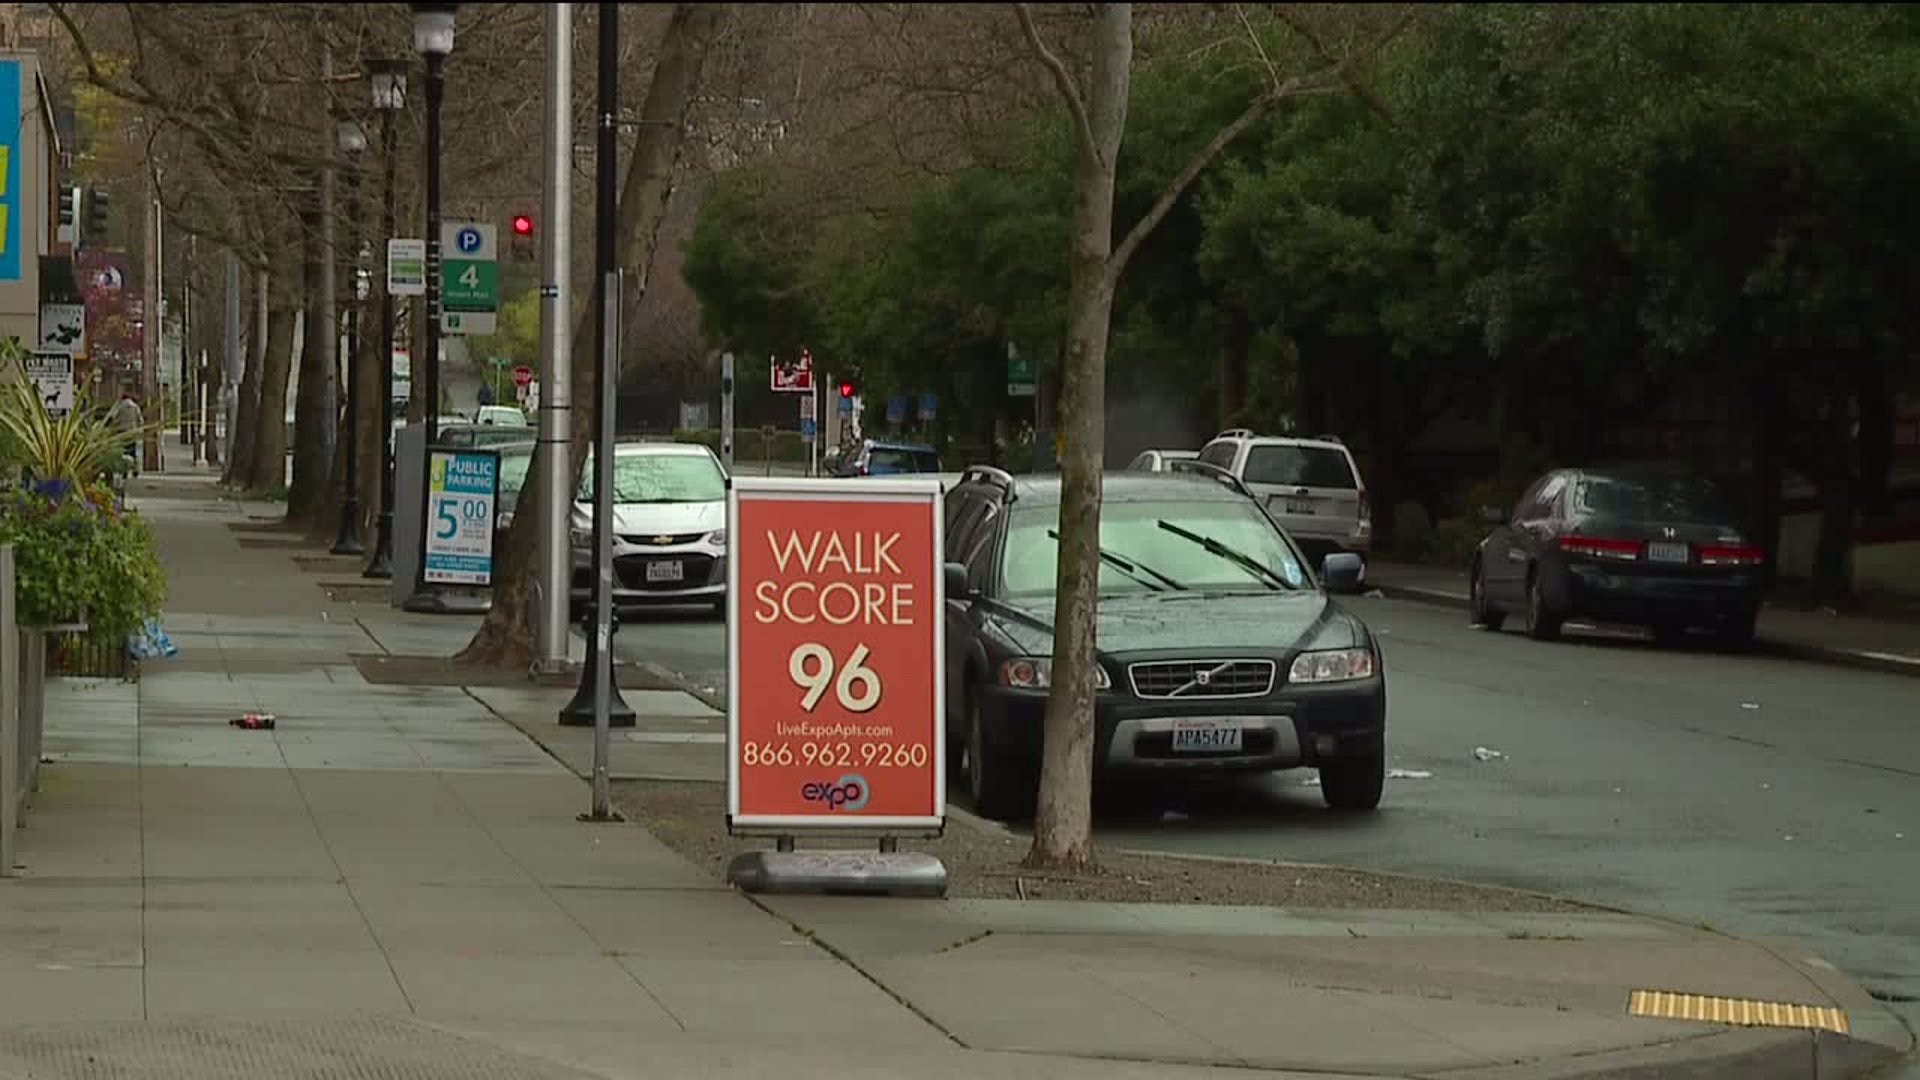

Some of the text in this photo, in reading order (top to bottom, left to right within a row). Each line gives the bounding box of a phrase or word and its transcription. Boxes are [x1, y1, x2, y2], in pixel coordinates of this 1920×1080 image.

[463, 233, 477, 249] P
[459, 264, 479, 289] 4
[448, 460, 492, 475] PUBLIC
[447, 475, 491, 488] PARKING
[767, 529, 902, 574] WALK
[755, 580, 914, 625] SCORE
[789, 642, 882, 713] 96
[776, 720, 893, 740] LiveExpoApts.com
[1175, 728, 1237, 746] APA5477
[743, 741, 928, 768] 866.962.9260
[802, 781, 861, 810] expo
